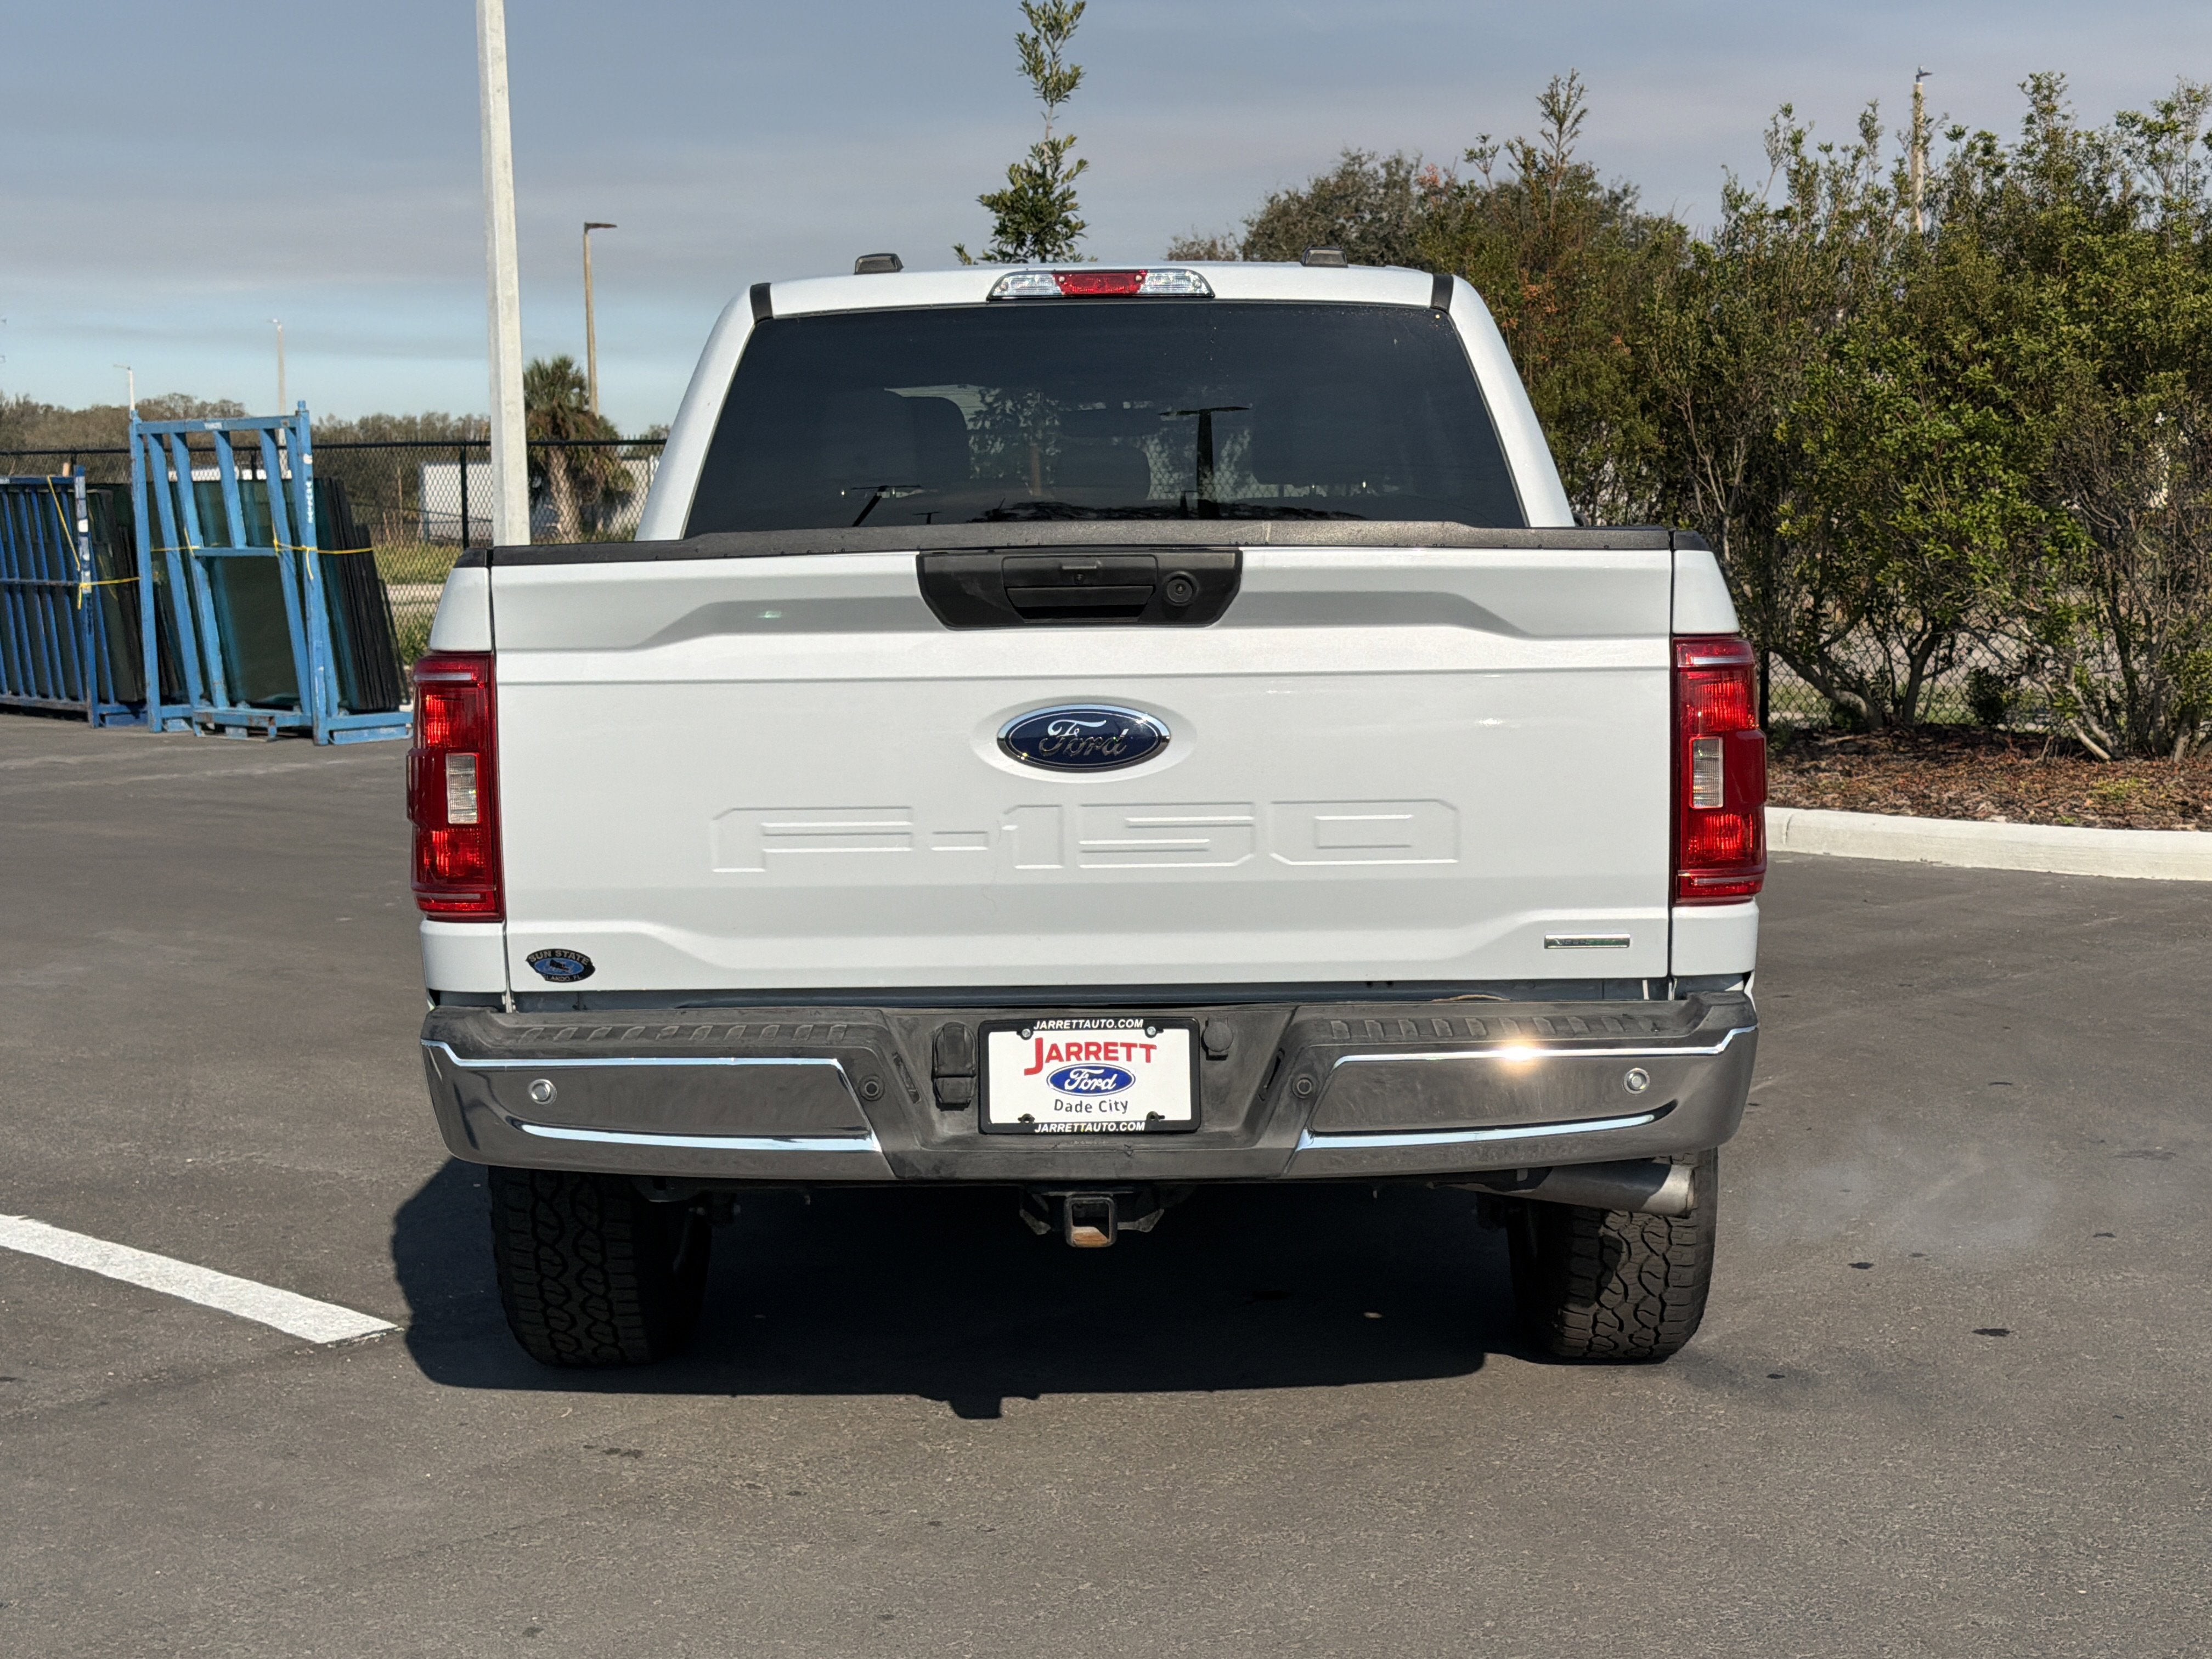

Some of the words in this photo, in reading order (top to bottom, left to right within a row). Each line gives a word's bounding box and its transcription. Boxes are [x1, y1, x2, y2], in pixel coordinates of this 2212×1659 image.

[1038, 719, 1129, 757] Ford
[712, 799, 1459, 873] F-150
[528, 950, 551, 962] SUN
[555, 950, 590, 965] STATE
[1034, 1019, 1144, 1030] JARRETTAUTO.COM
[1024, 1037, 1157, 1076] JARRETT
[1064, 1068, 1118, 1091] Ford
[1054, 1098, 1093, 1113] Dade
[1098, 1099, 1128, 1114] City
[1035, 1121, 1145, 1133] JARRETTAUTO.COM
